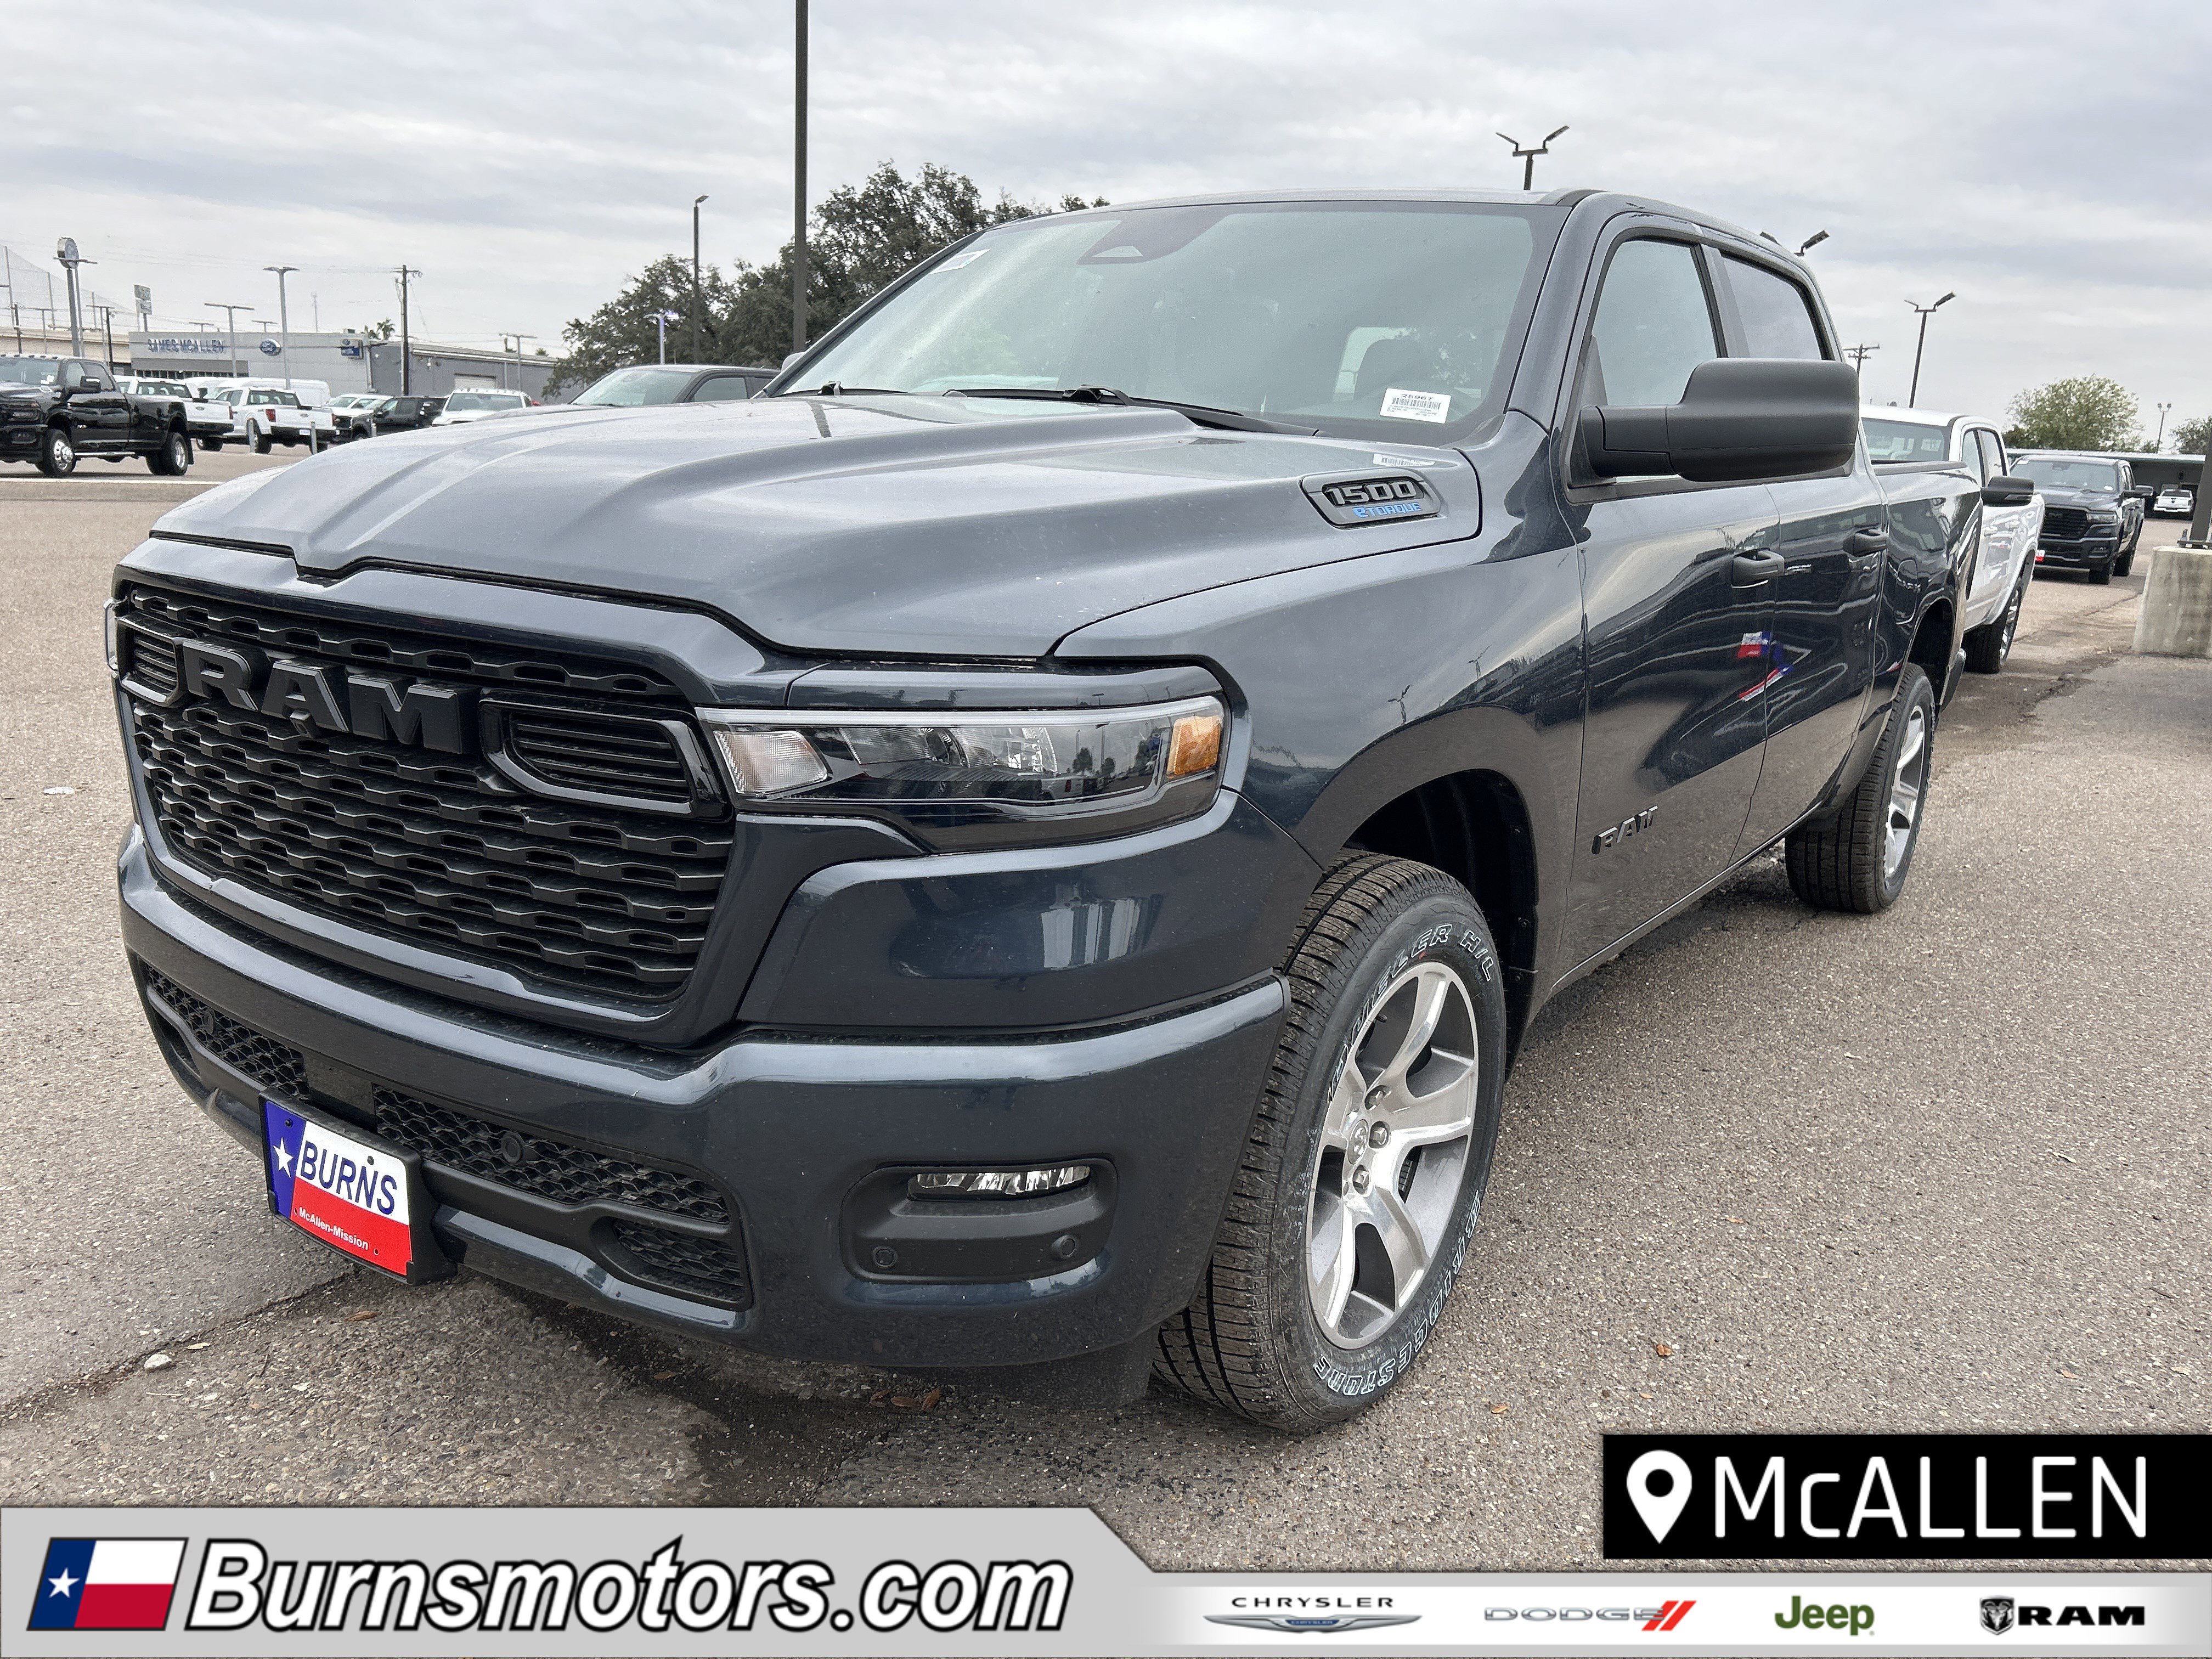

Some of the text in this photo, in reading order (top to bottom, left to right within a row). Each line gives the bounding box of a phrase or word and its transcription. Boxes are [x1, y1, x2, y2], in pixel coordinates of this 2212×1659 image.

[1324, 481, 1417, 505] 1500
[183, 639, 473, 754] RAM
[1591, 805, 1658, 855] RAM
[300, 1141, 398, 1215] BURNS
[298, 1206, 369, 1251] McAllen-Mission
[1314, 1189, 1481, 1396] BRIDGESTONE
